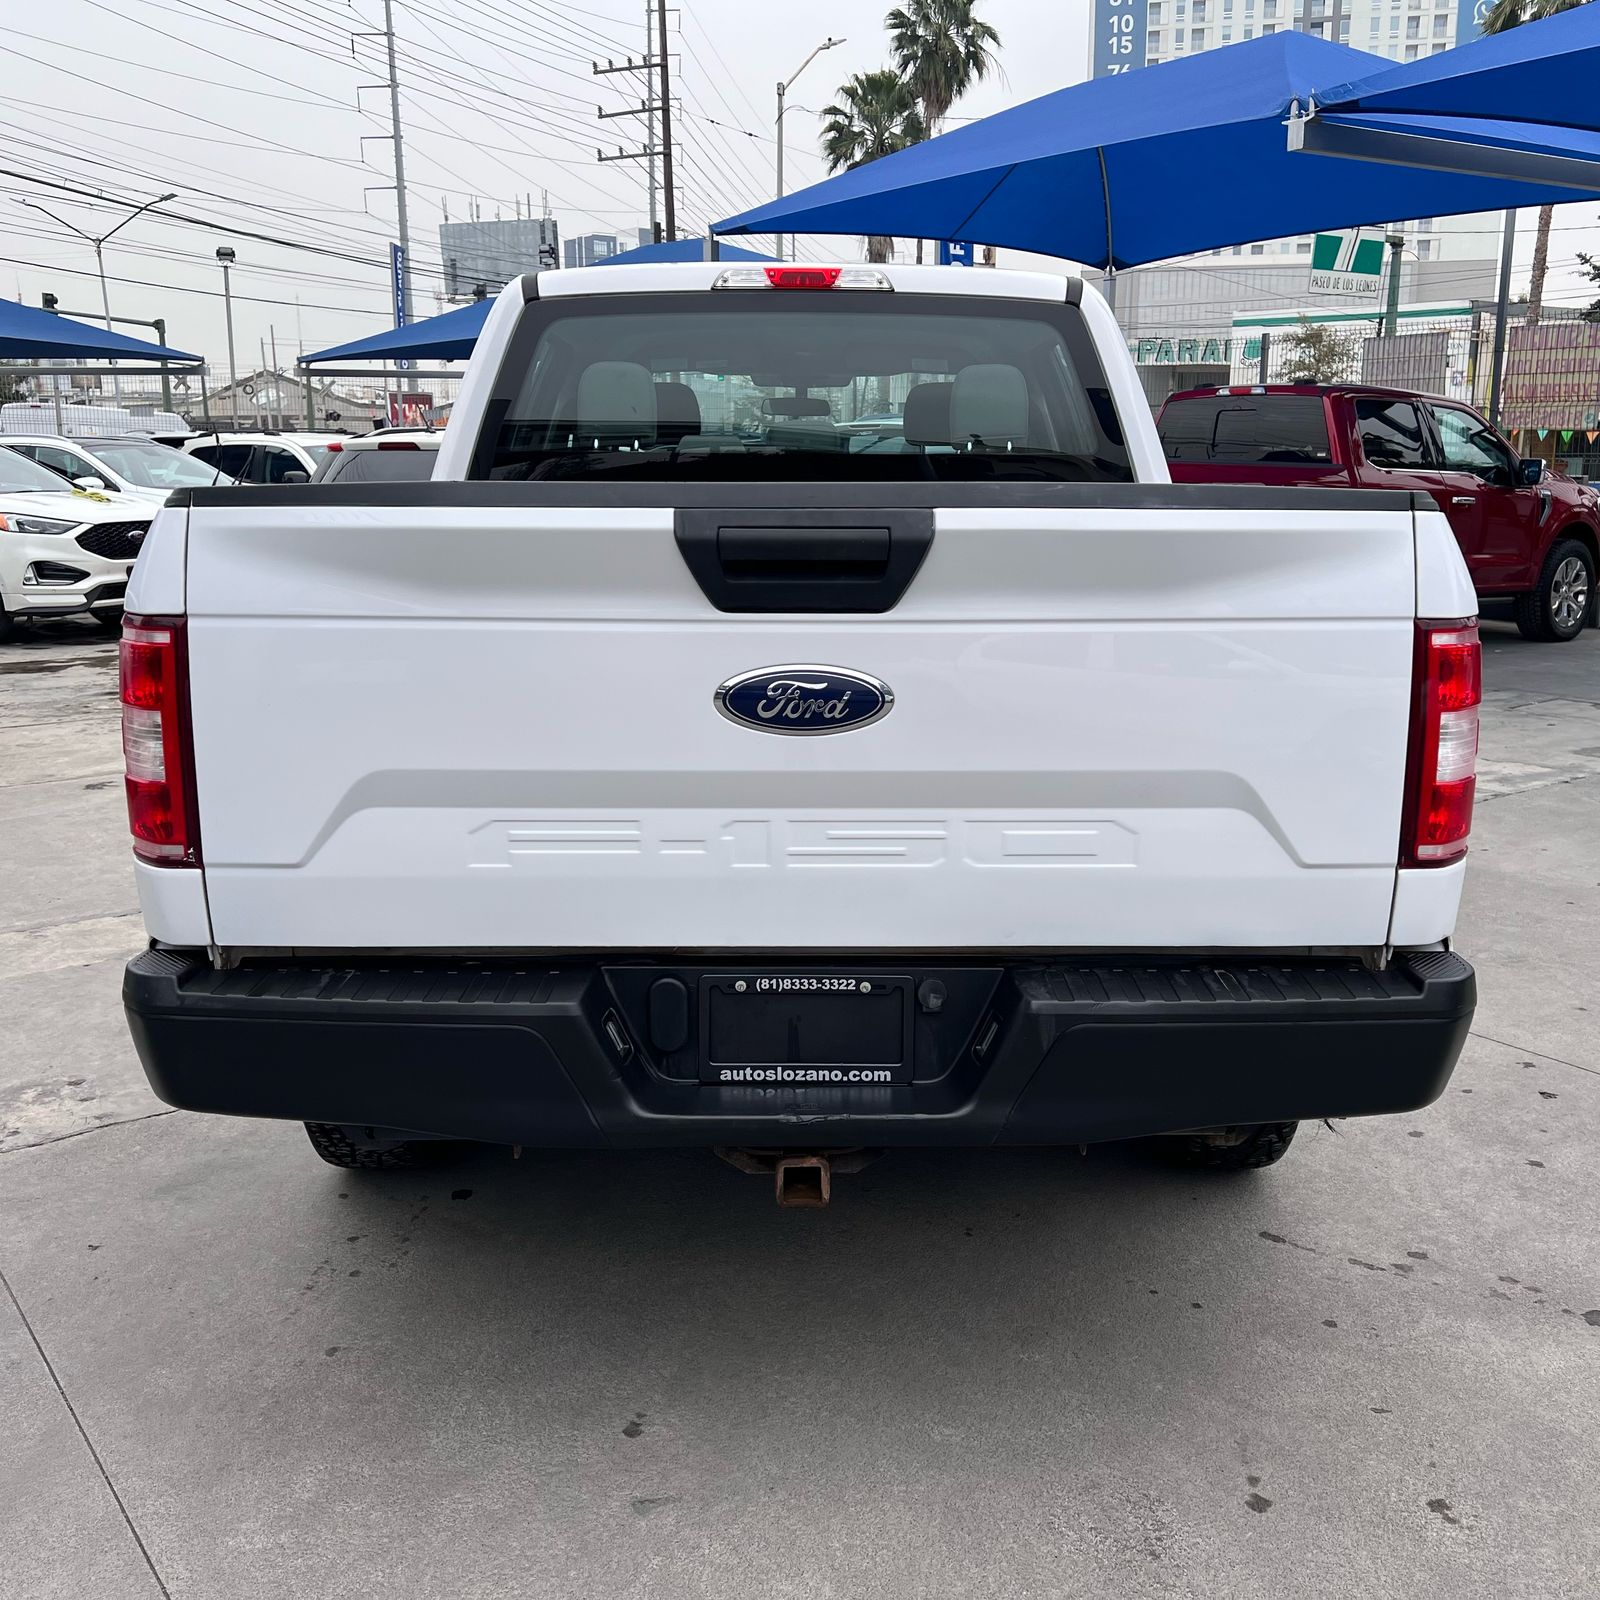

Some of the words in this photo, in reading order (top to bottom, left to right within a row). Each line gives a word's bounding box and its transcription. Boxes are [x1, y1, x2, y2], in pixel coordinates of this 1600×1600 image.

[1109, 14, 1134, 34] 10
[1108, 36, 1133, 55] 15
[1311, 275, 1331, 289] PASEO
[1332, 277, 1341, 290] DE
[1342, 278, 1354, 291] LOS
[1355, 279, 1378, 293] LEONES
[757, 680, 851, 719] Ford
[466, 819, 1141, 868] F-150
[755, 978, 856, 992] (81)8333-3322
[719, 1066, 892, 1082] autoslozano.com
